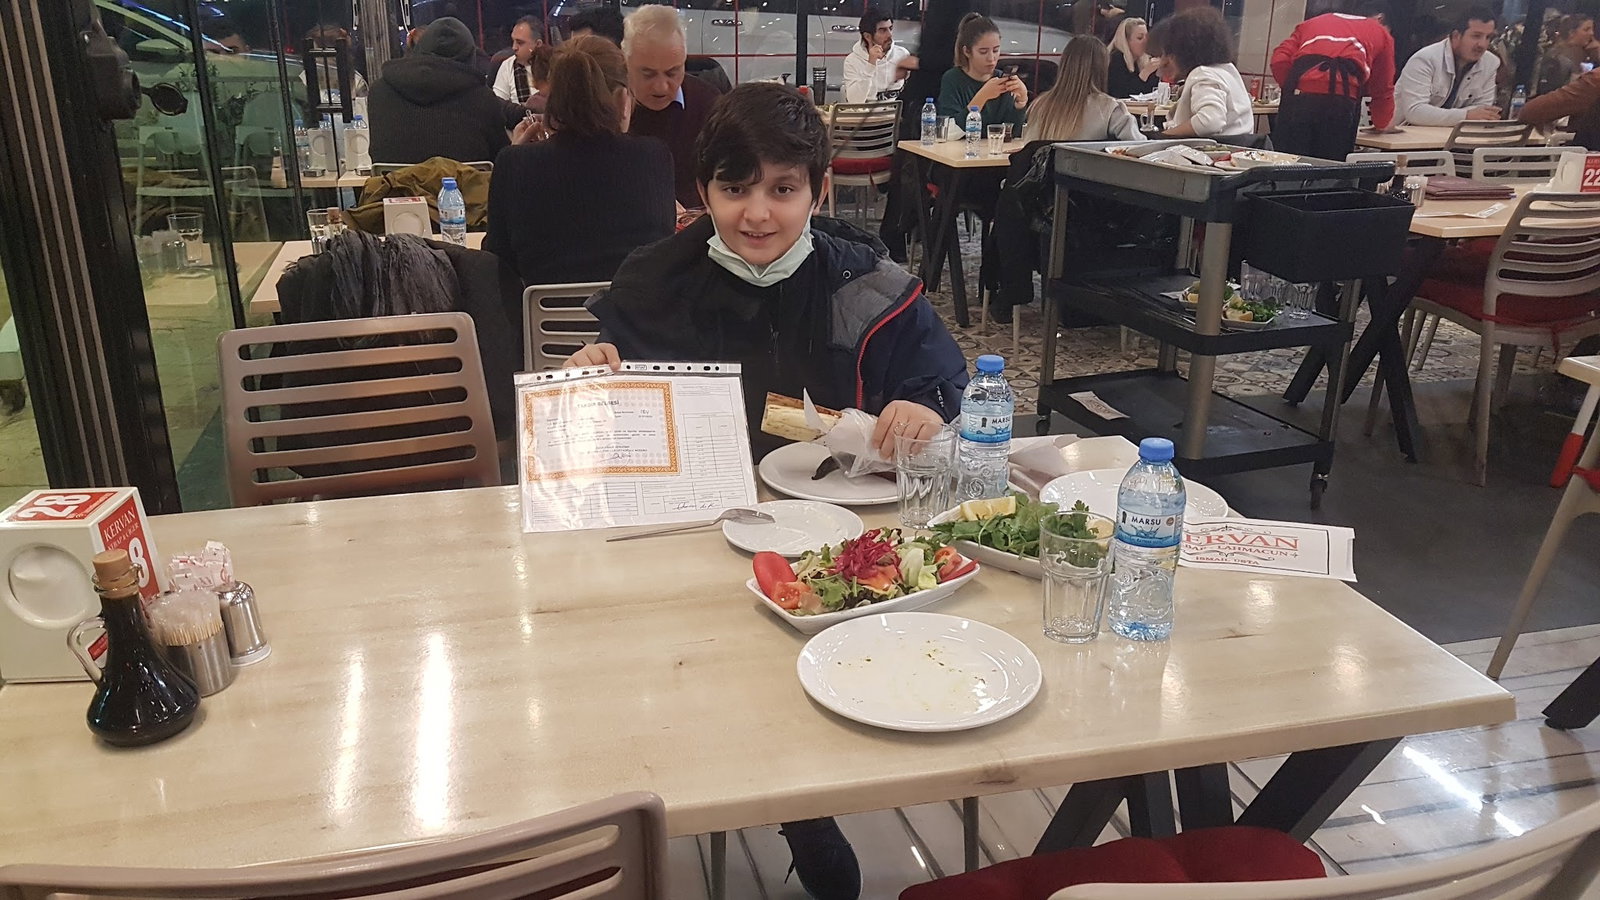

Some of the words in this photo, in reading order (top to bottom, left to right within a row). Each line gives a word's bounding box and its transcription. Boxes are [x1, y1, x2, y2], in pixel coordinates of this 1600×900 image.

[1583, 168, 1600, 187] 22
[17, 494, 92, 518] 28
[103, 507, 136, 542] KERVAN
[1131, 515, 1162, 526] MARSU
[1185, 533, 1300, 550] ERVAN
[1217, 545, 1288, 557] LAHMACUN
[128, 537, 150, 588] 8
